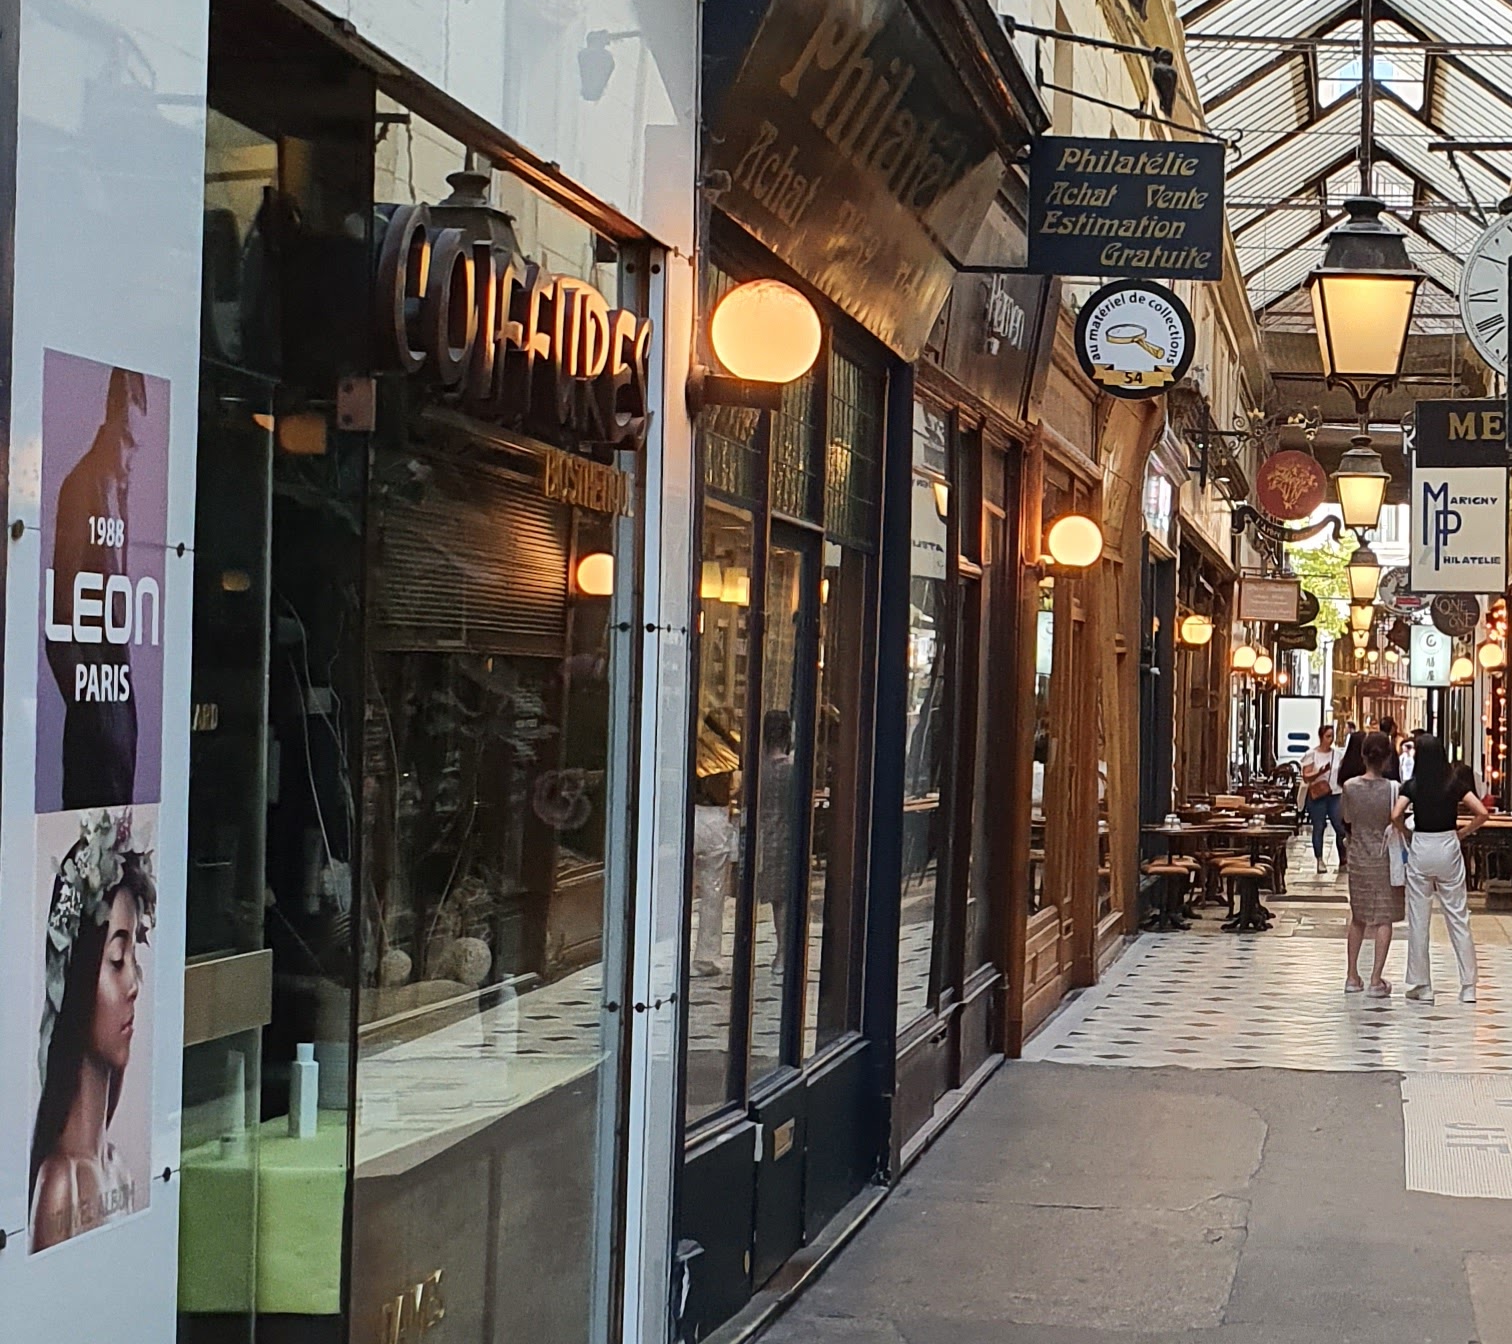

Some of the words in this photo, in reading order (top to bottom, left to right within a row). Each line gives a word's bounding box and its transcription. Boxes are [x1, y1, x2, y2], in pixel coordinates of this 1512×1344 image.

[1056, 147, 1200, 176] Philatélie
[1045, 181, 1118, 207] Achat
[1146, 184, 1209, 210] Vente
[1040, 211, 1187, 239] Estimation
[1100, 242, 1212, 270] Gratuite
[1129, 292, 1146, 305] de
[1089, 292, 1127, 342] matériel
[1148, 297, 1183, 365] collections
[1092, 344, 1101, 361] au
[1124, 371, 1143, 385] 54
[88, 516, 125, 548] 1988
[75, 664, 130, 702] PARIS
